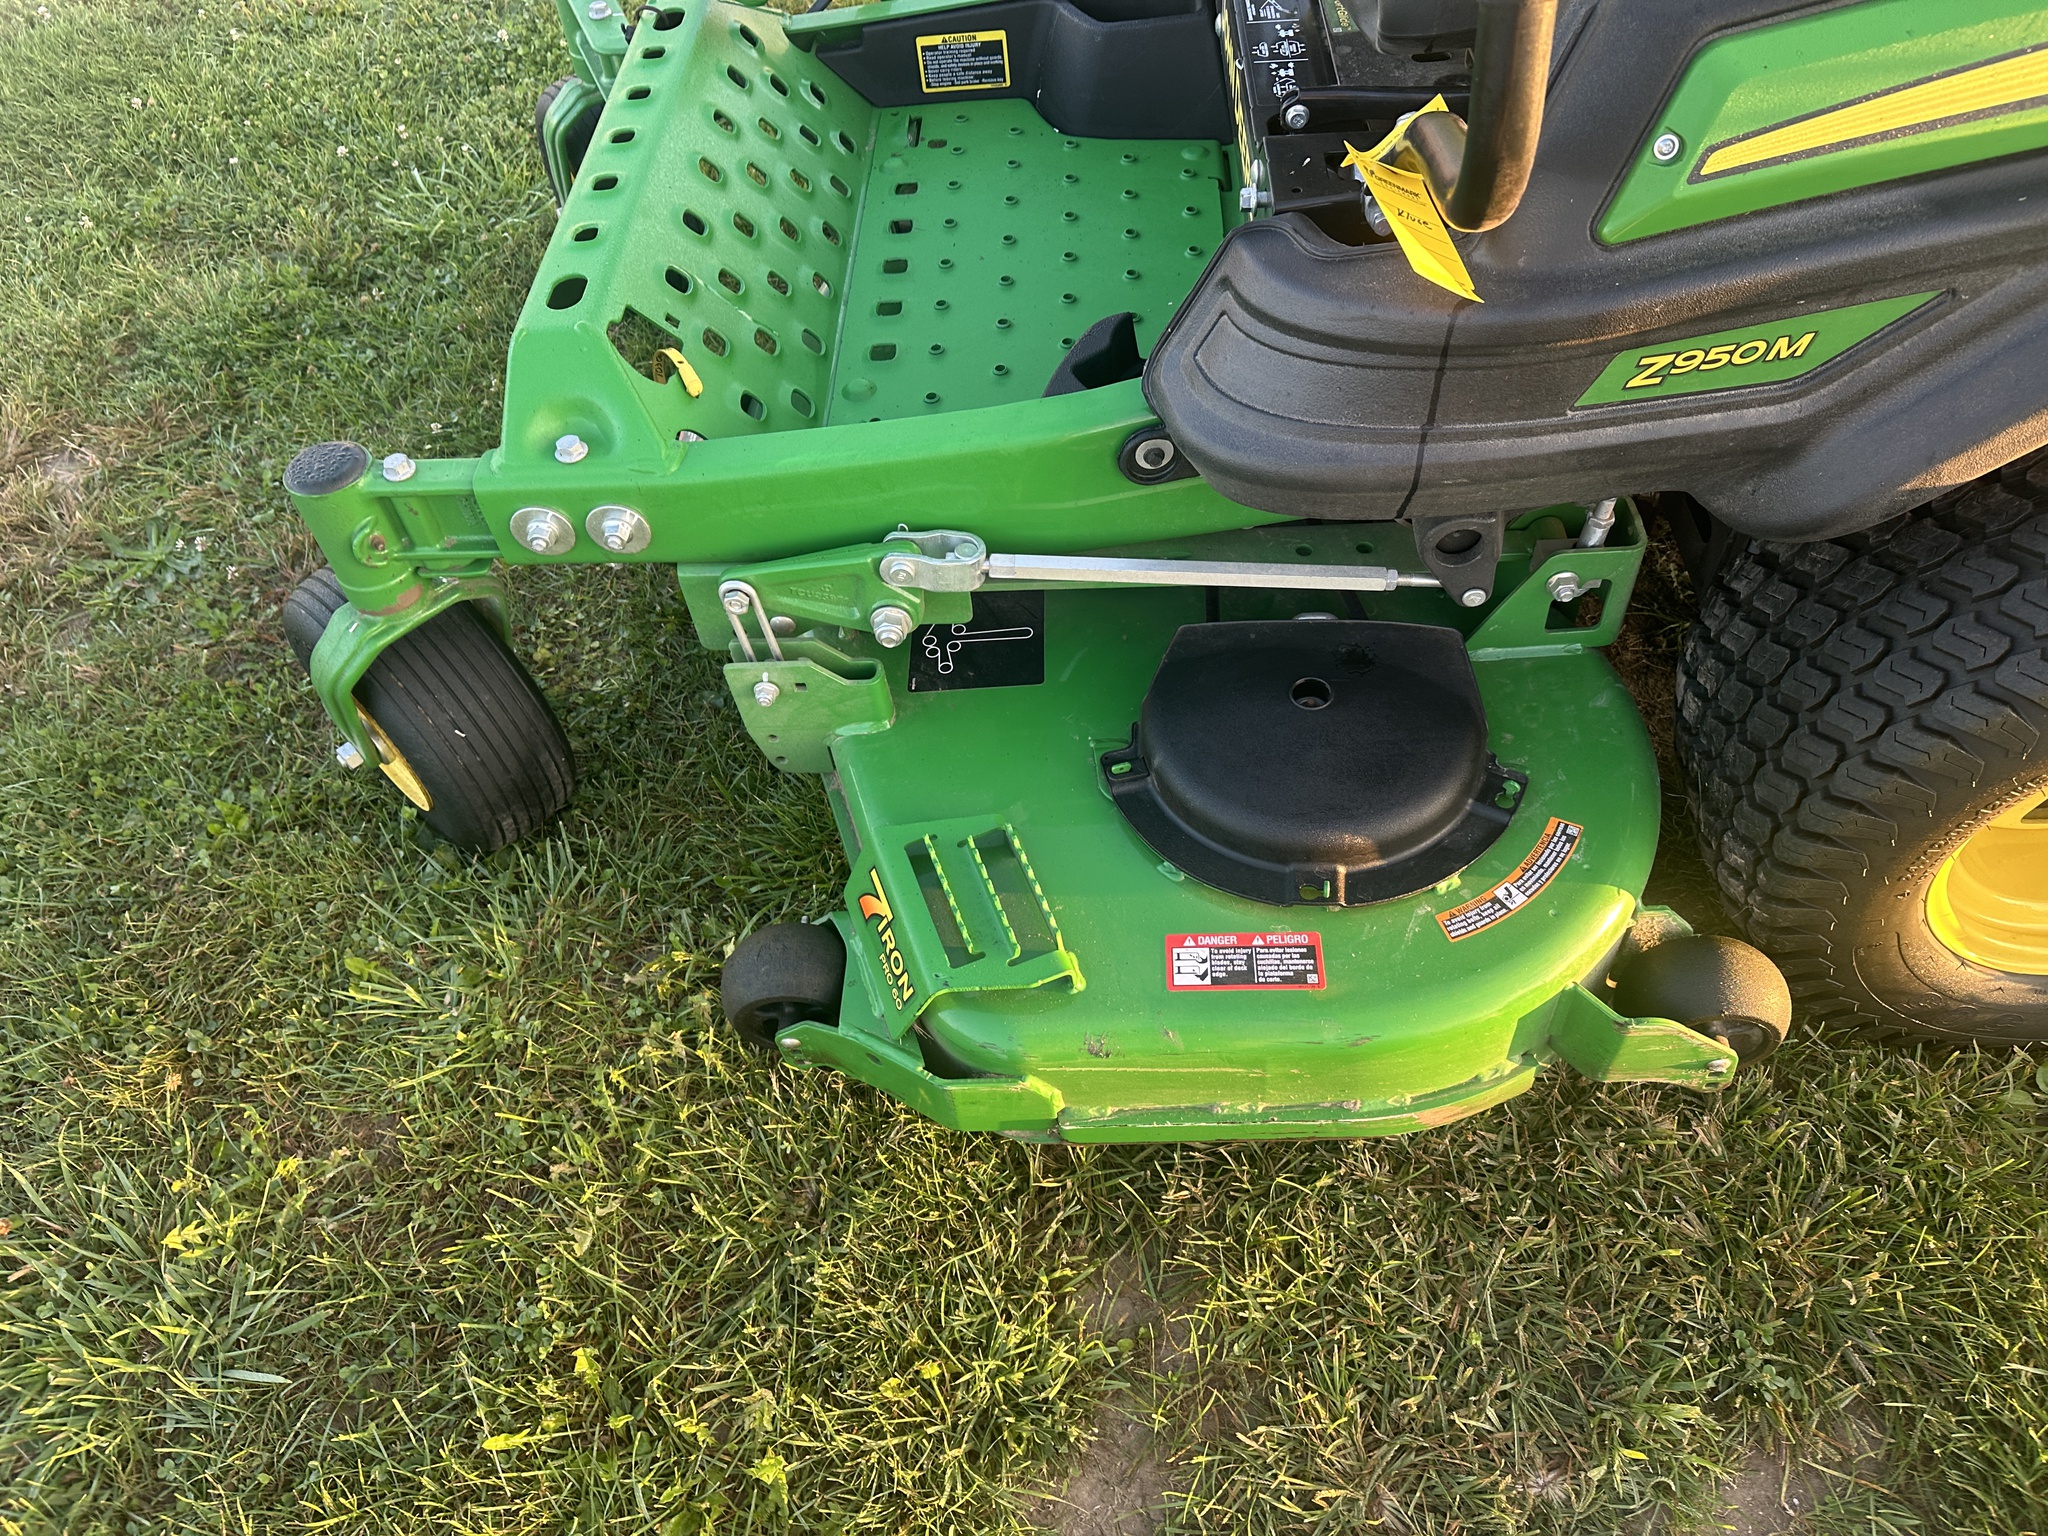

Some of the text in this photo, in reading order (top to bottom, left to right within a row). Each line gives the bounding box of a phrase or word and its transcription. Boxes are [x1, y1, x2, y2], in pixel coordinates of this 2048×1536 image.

[1623, 330, 1819, 390] Z950M
[1523, 833, 1551, 868] ADVERTENCIA
[1455, 895, 1486, 914] WARNING
[1198, 936, 1237, 944] DANGER
[1267, 935, 1308, 944] PELIGRO
[878, 954, 903, 1011] PRO 60
